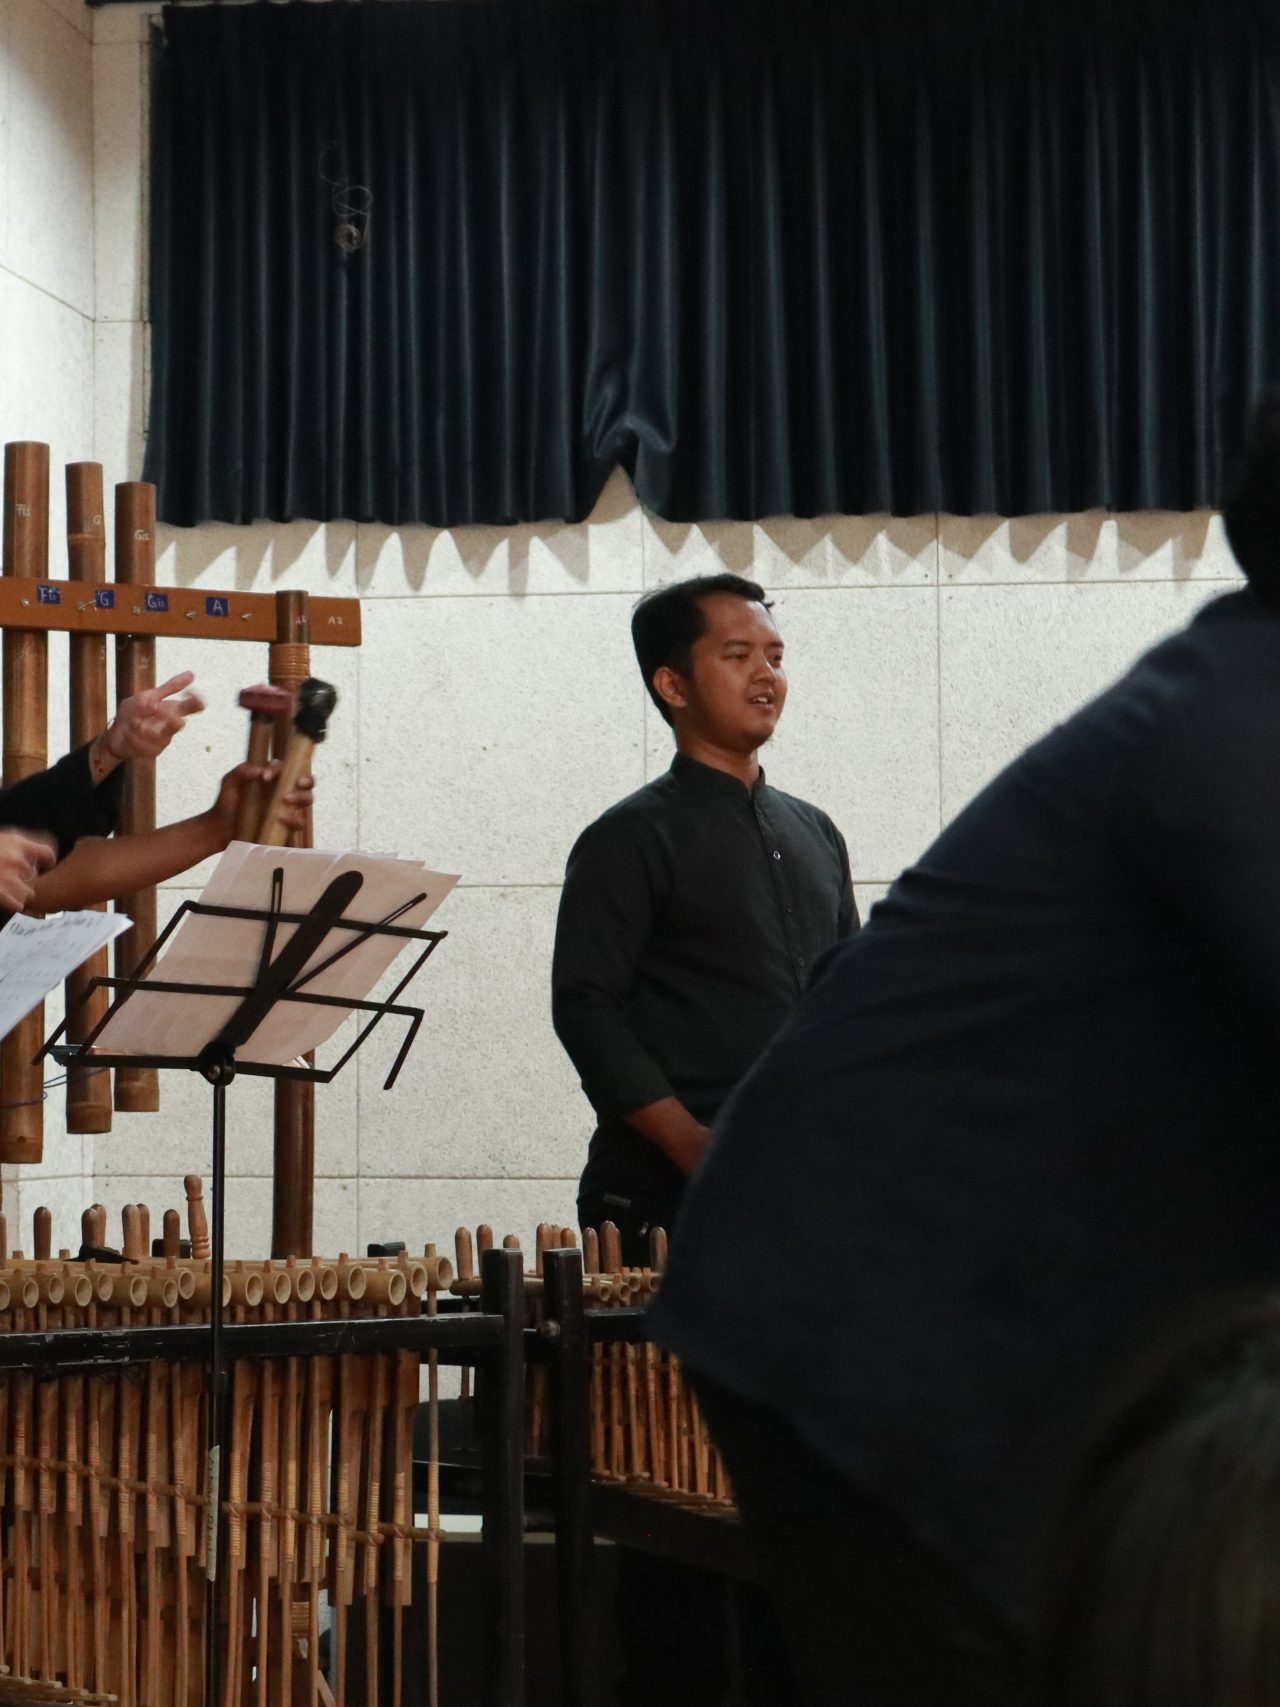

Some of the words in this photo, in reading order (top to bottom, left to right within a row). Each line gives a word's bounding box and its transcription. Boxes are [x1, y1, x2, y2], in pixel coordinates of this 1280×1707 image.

[92, 515, 102, 525] G
[99, 591, 110, 607] G
[212, 599, 224, 616] A
